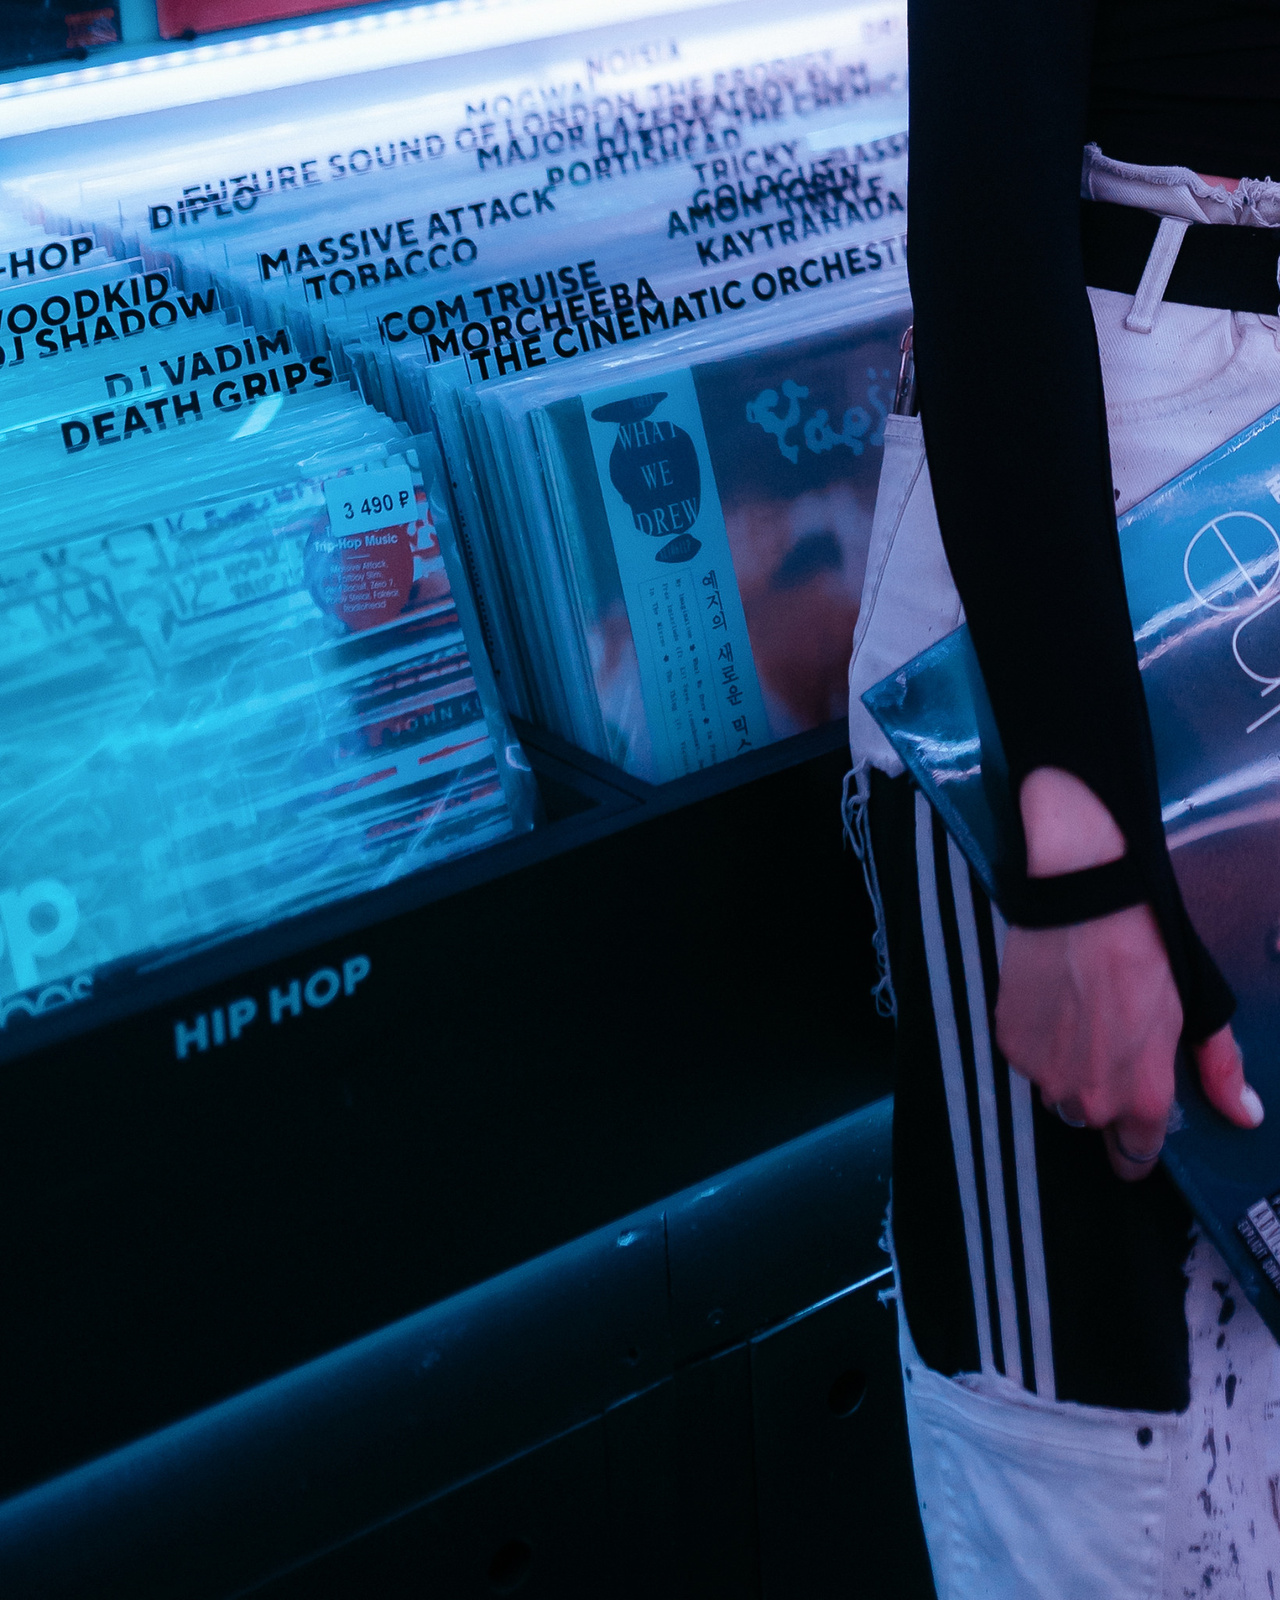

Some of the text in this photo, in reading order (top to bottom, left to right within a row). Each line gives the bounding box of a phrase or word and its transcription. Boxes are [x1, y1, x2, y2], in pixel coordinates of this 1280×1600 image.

[328, 132, 446, 181] SOUND
[455, 121, 497, 153] OF
[477, 122, 585, 172] MAJOR
[692, 138, 797, 184] TRICKY
[147, 185, 260, 232] DIPLO
[258, 184, 557, 283] MASSIVE ATTACK
[696, 189, 905, 267] KAYTRANADA
[303, 236, 479, 301] TOBACCO
[0, 273, 169, 336] OODKID
[35, 288, 217, 360] SHADOW
[381, 260, 602, 343] COM TRUISE
[424, 277, 658, 363] MORCHEEBA
[466, 231, 909, 382] THE CINEMATIC ORCHEST
[159, 329, 292, 388] VADIM
[61, 355, 334, 454] DEATH GRIPS
[617, 418, 679, 451] WHAT
[640, 458, 674, 489] WE
[343, 502, 355, 519] 3
[361, 494, 394, 516] 490
[636, 496, 698, 535] DREW
[365, 532, 399, 548] Music
[174, 997, 258, 1061] HIP
[268, 954, 372, 1025] HOP
